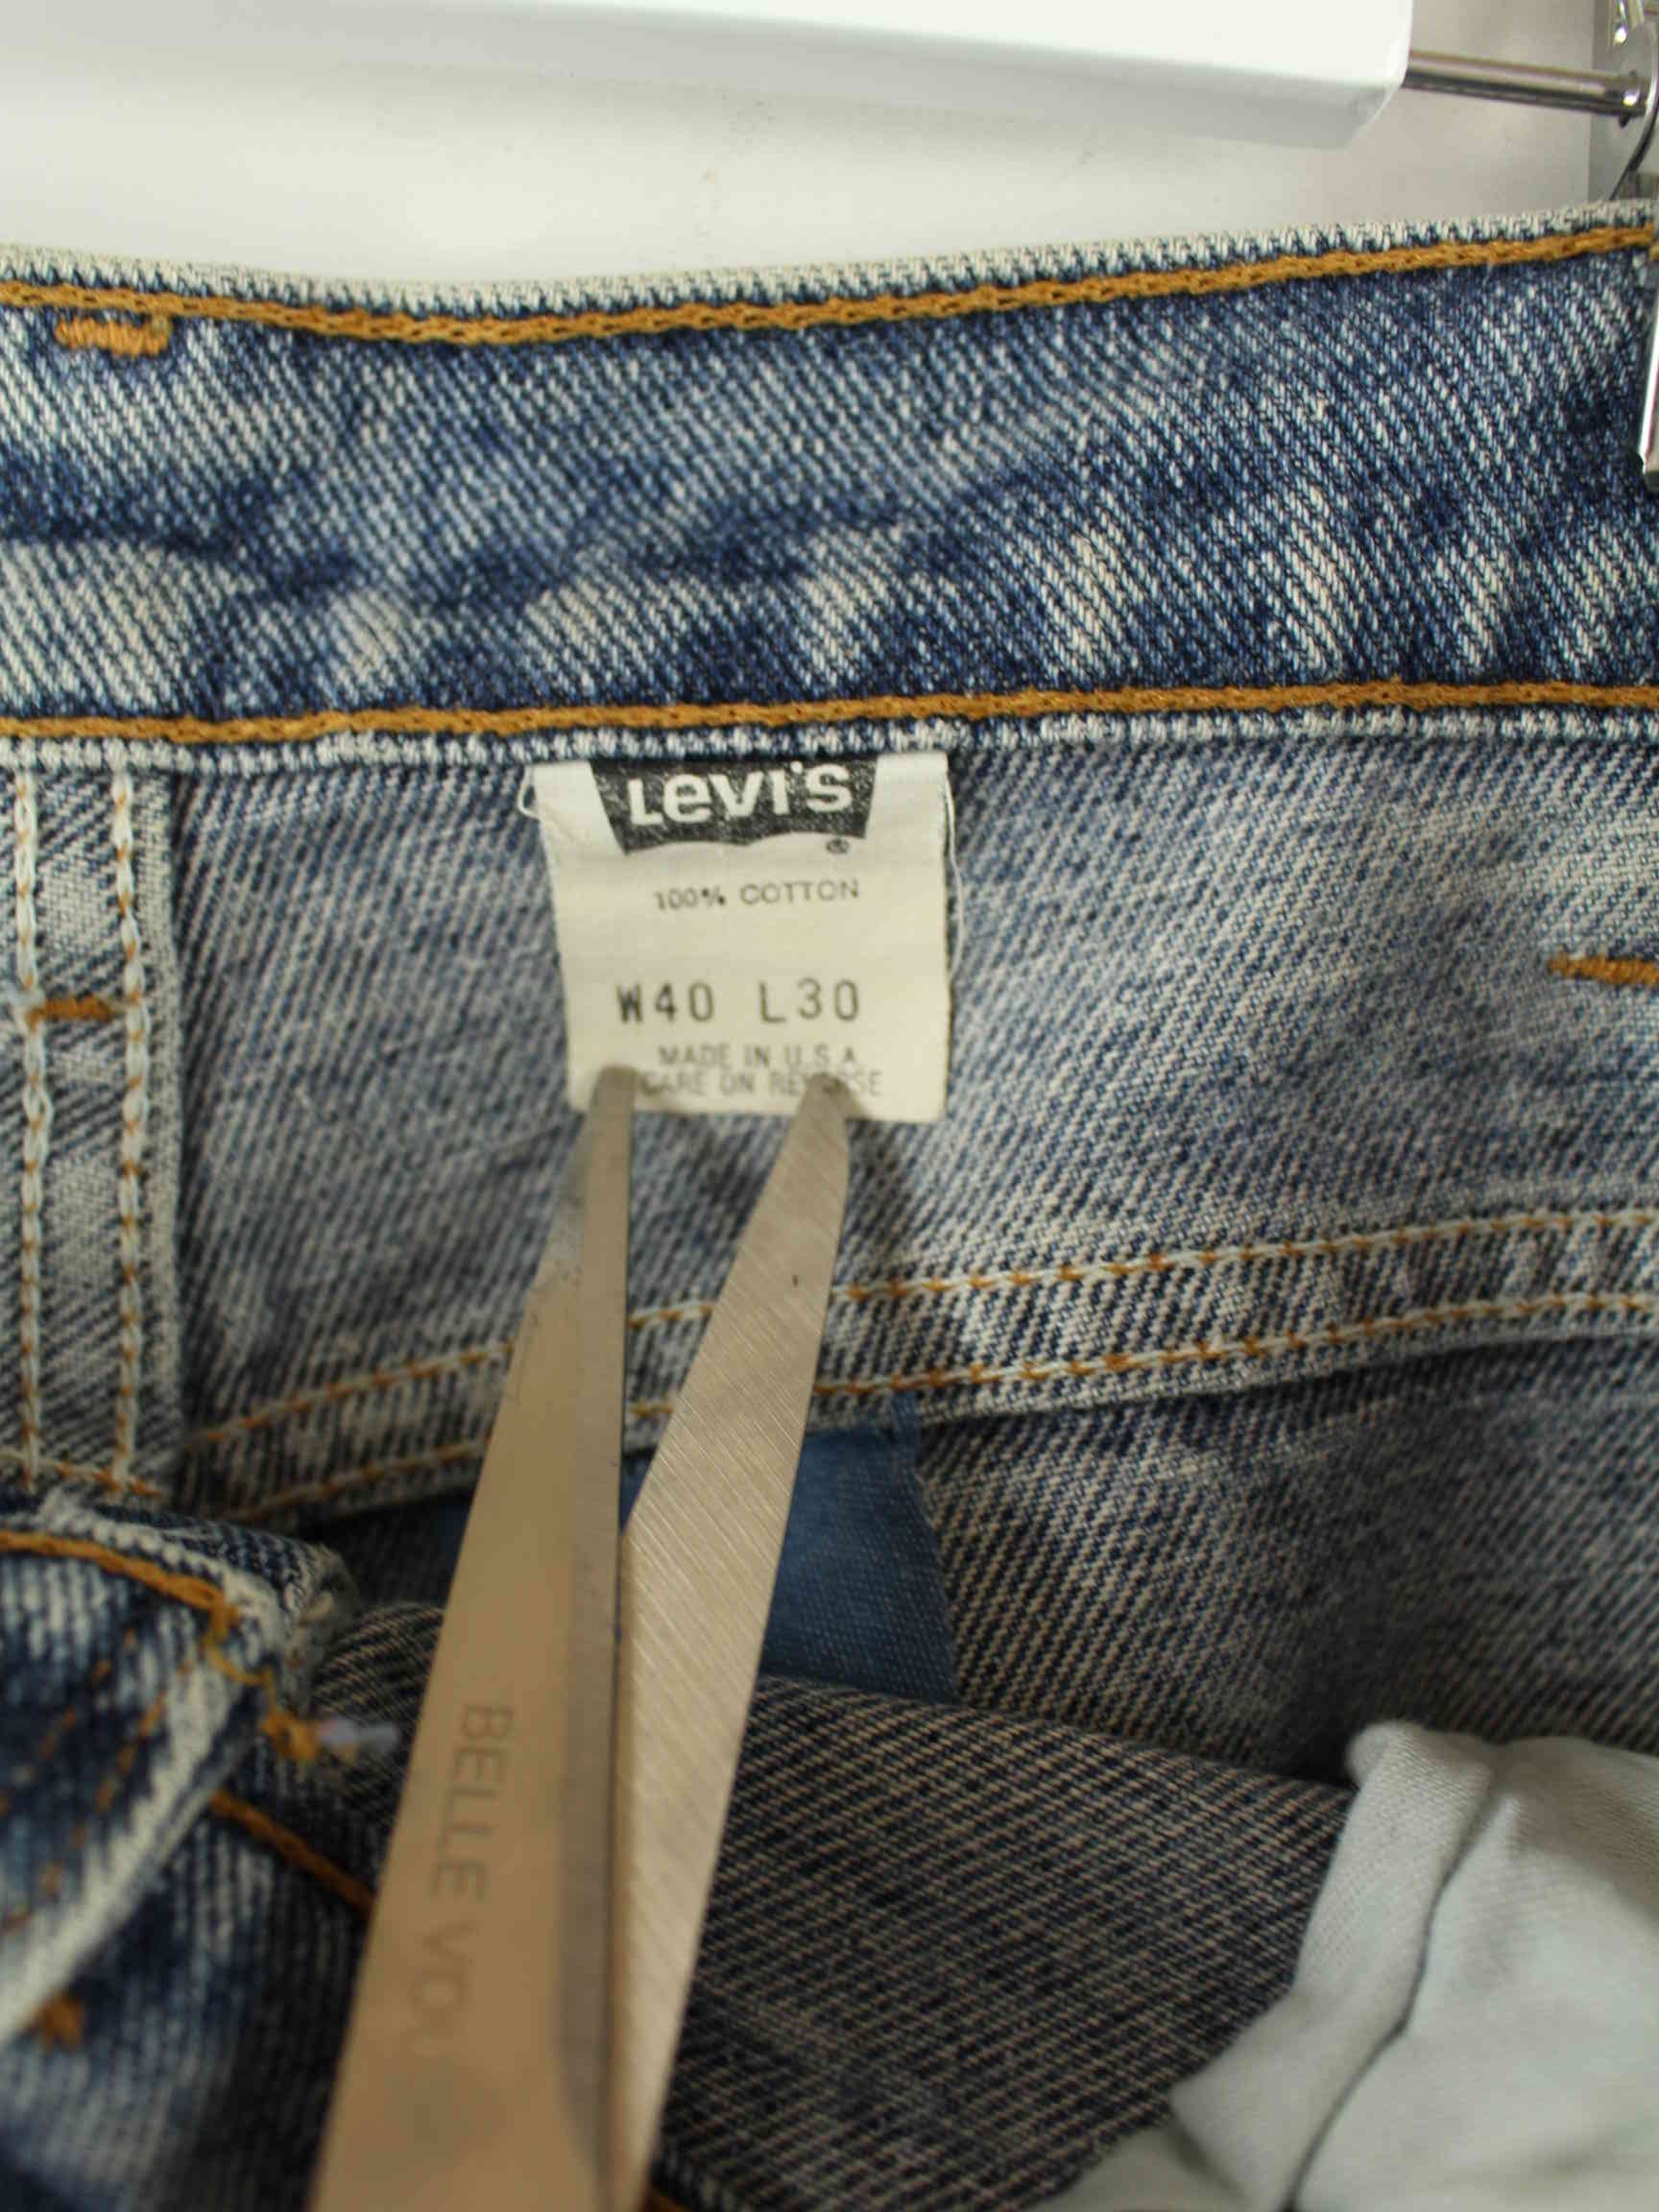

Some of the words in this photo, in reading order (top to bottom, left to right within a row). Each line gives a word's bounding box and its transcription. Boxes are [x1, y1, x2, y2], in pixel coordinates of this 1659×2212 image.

[628, 760, 854, 827] Levi's
[655, 885, 727, 911] 100%
[739, 876, 860, 905] COTTON
[616, 981, 715, 1024] W40
[757, 977, 860, 1023] L30
[658, 1043, 731, 1068] MADE
[743, 1044, 770, 1069] IN
[430, 1705, 515, 1902] BELLE
